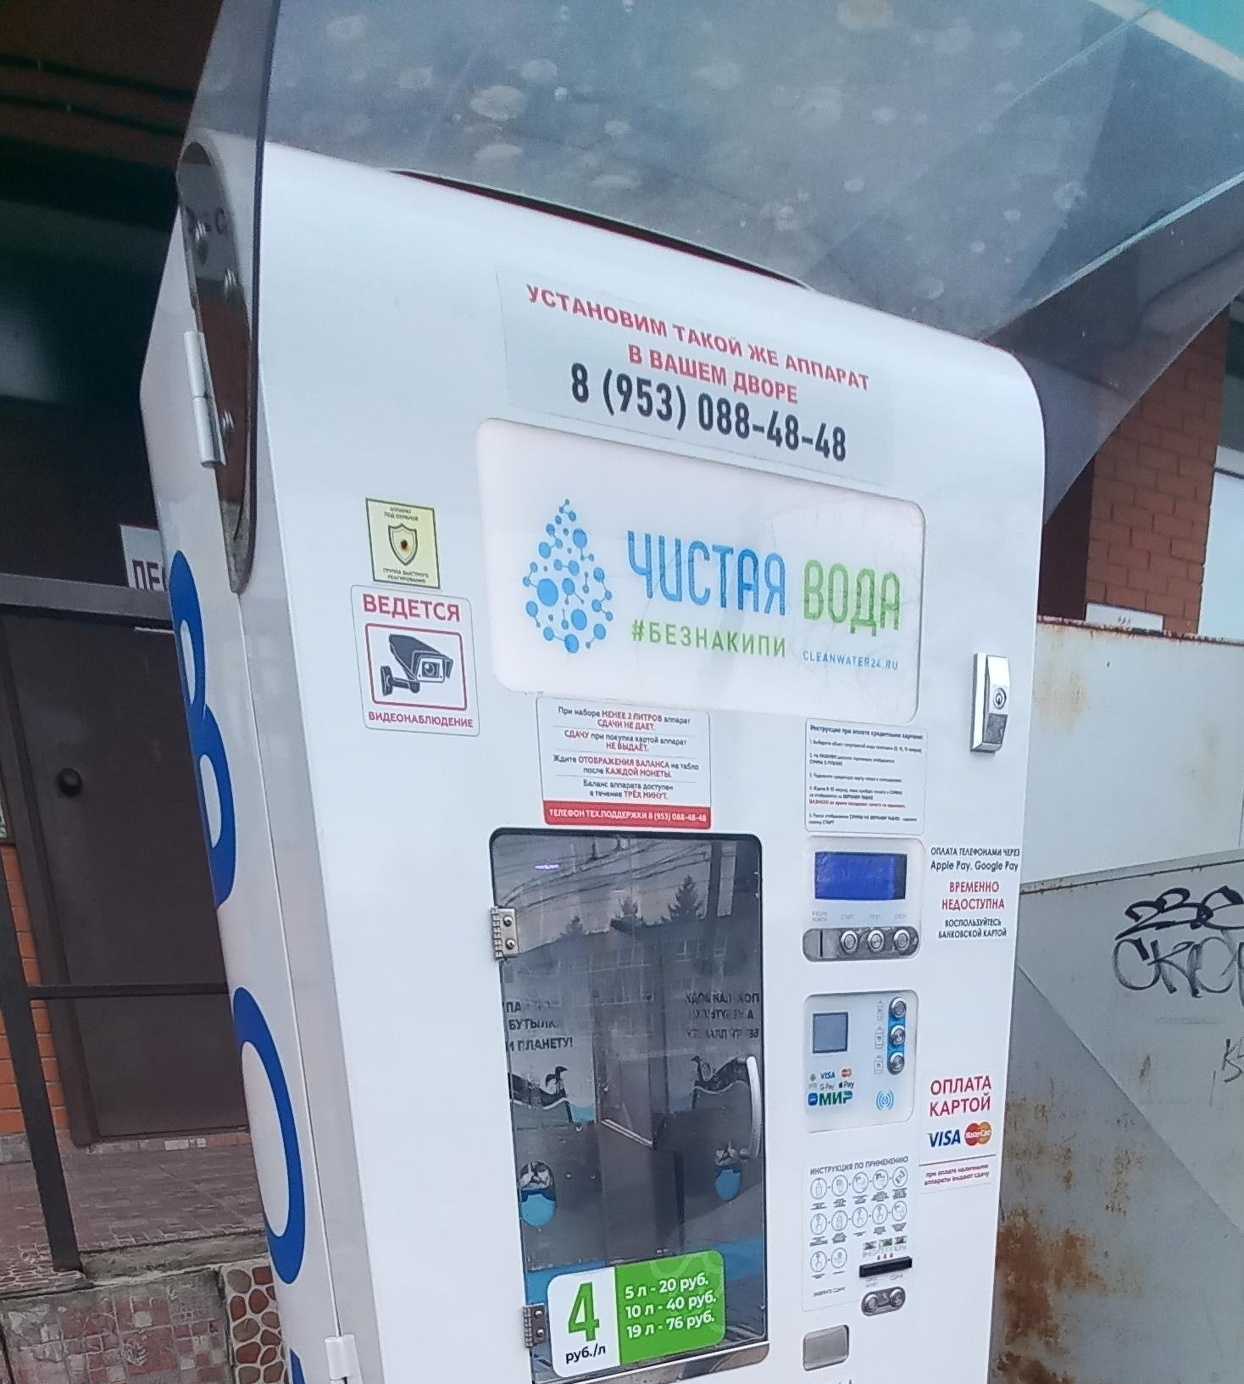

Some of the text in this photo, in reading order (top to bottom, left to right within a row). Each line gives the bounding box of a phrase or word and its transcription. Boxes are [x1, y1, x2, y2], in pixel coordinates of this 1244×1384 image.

[526, 283, 870, 391] УСТАНОВИМ ТАКОЙ ЖЕ АППАРАТ
[628, 344, 798, 404] В ВАШЕМ ДВОРЕ
[571, 362, 847, 462] 8 (953) 088-48-48
[627, 530, 900, 636] ЧИСТАЯ ВОДА
[362, 593, 461, 622] ВЕДЕТСЯ
[631, 618, 786, 657] #БЕЗНАКИПИ
[802, 650, 899, 671] CLEANWATER24.RU
[368, 711, 474, 729] ВИДЕОНАБЛЮДЕНИЕ
[597, 719, 622, 728] СДАЧИ
[624, 721, 634, 730] НЕ
[632, 712, 663, 723] ЛИТРОВ
[564, 730, 589, 739] СДАЧУ
[606, 742, 616, 750] НЕ
[578, 756, 635, 766] ОТОБРАЖЕНИЯ
[605, 768, 639, 778] КАЖДОЙ
[549, 808, 585, 818] ТЕЛЕФОН
[931, 847, 1020, 857] ОПЛАТА ТЕЛЕФОНАМИ ЧЕРЕЗ
[930, 861, 954, 872] Apple
[974, 861, 1003, 872] Google
[1005, 861, 1019, 872] Pay
[949, 881, 1000, 893] ВРЕМЕННО
[941, 898, 1005, 911] НЕДОСТУПНА
[945, 917, 1001, 928] ВОСПОЛЬЗУЙТЕСЬ
[938, 928, 1007, 939] БАНКОВСКОЙ КАРТОЙ
[517, 1036, 573, 1052] ПЛАНЕТУ!
[930, 1075, 992, 1095] ОПЛАТА
[819, 1090, 853, 1106] МИР
[929, 1092, 990, 1117] КАРТОЙ
[928, 1129, 961, 1148] VISA
[810, 1156, 909, 1175] ИНСТРУКЦИЯ ПО ПРИМЕНЕНИЮ
[625, 1286, 635, 1299] 5
[637, 1285, 647, 1297] л
[659, 1279, 677, 1293] 20
[680, 1272, 709, 1293] руб.
[568, 1282, 600, 1342] 4
[625, 1305, 641, 1319] 10
[644, 1304, 655, 1316] л
[666, 1297, 684, 1311] 40
[688, 1290, 717, 1311] руб.
[626, 1325, 642, 1339] 19
[644, 1324, 655, 1336] л
[666, 1316, 684, 1331] 76
[687, 1309, 715, 1329] руб.
[565, 1343, 607, 1365] руб./л
